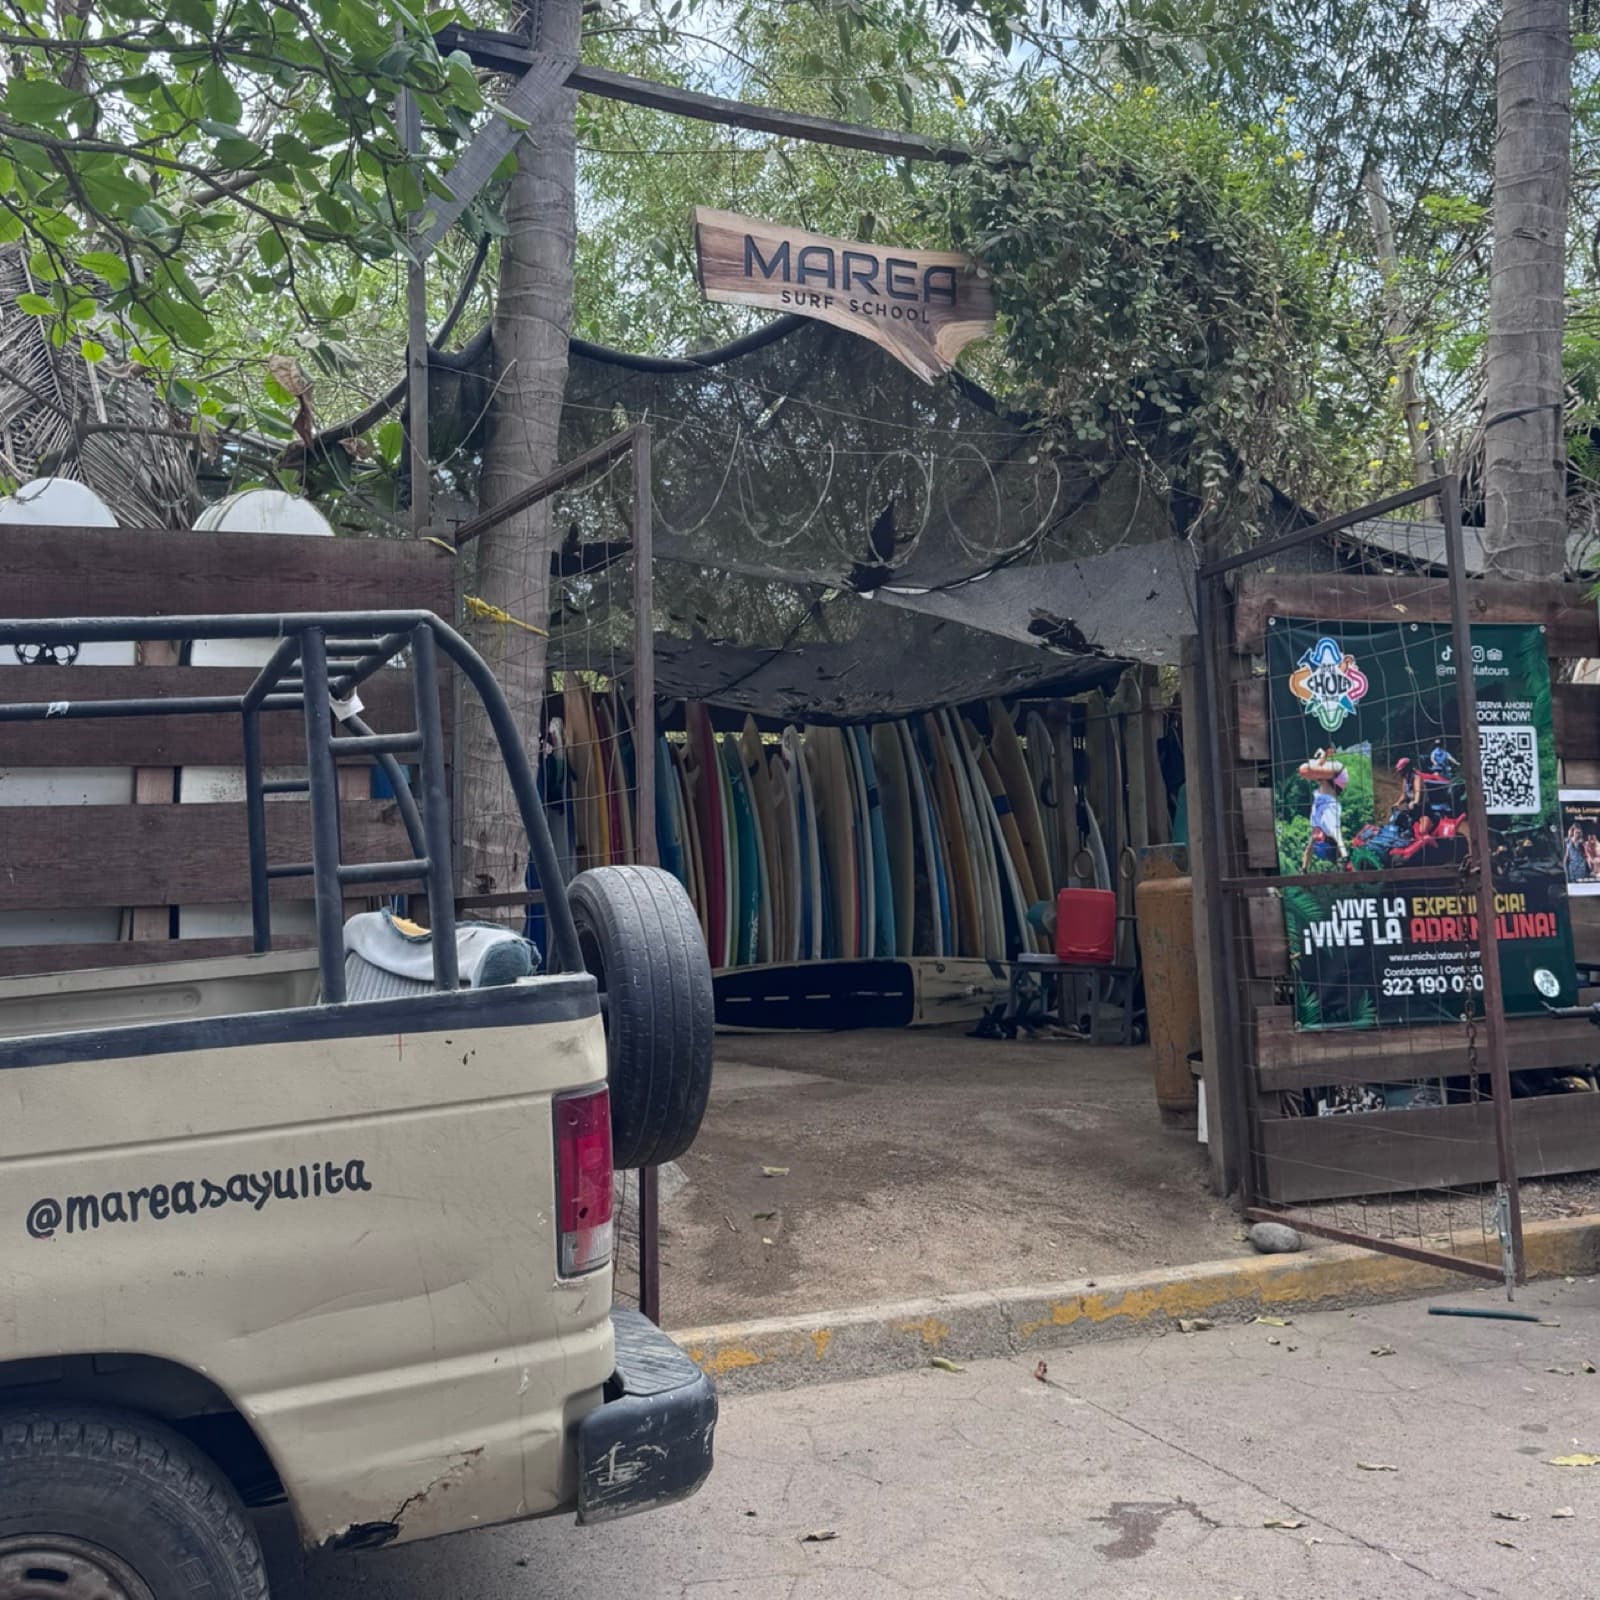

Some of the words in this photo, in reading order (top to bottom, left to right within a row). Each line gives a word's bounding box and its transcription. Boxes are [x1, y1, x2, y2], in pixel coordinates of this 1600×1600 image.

[743, 234, 957, 303] MAREA
[781, 290, 834, 309] SURF
[849, 299, 931, 324] SCHOOL
[1476, 710, 1501, 721] OOK
[1502, 710, 1531, 721] NOW!
[1331, 897, 1378, 924] ¡VIVE
[1383, 897, 1407, 918] LA
[1304, 920, 1364, 955] ¡VIVE
[1372, 919, 1402, 945] LA
[1382, 977, 1414, 996] 322
[1416, 976, 1447, 994] 190
[26, 1159, 372, 1239] @mareasayulita
